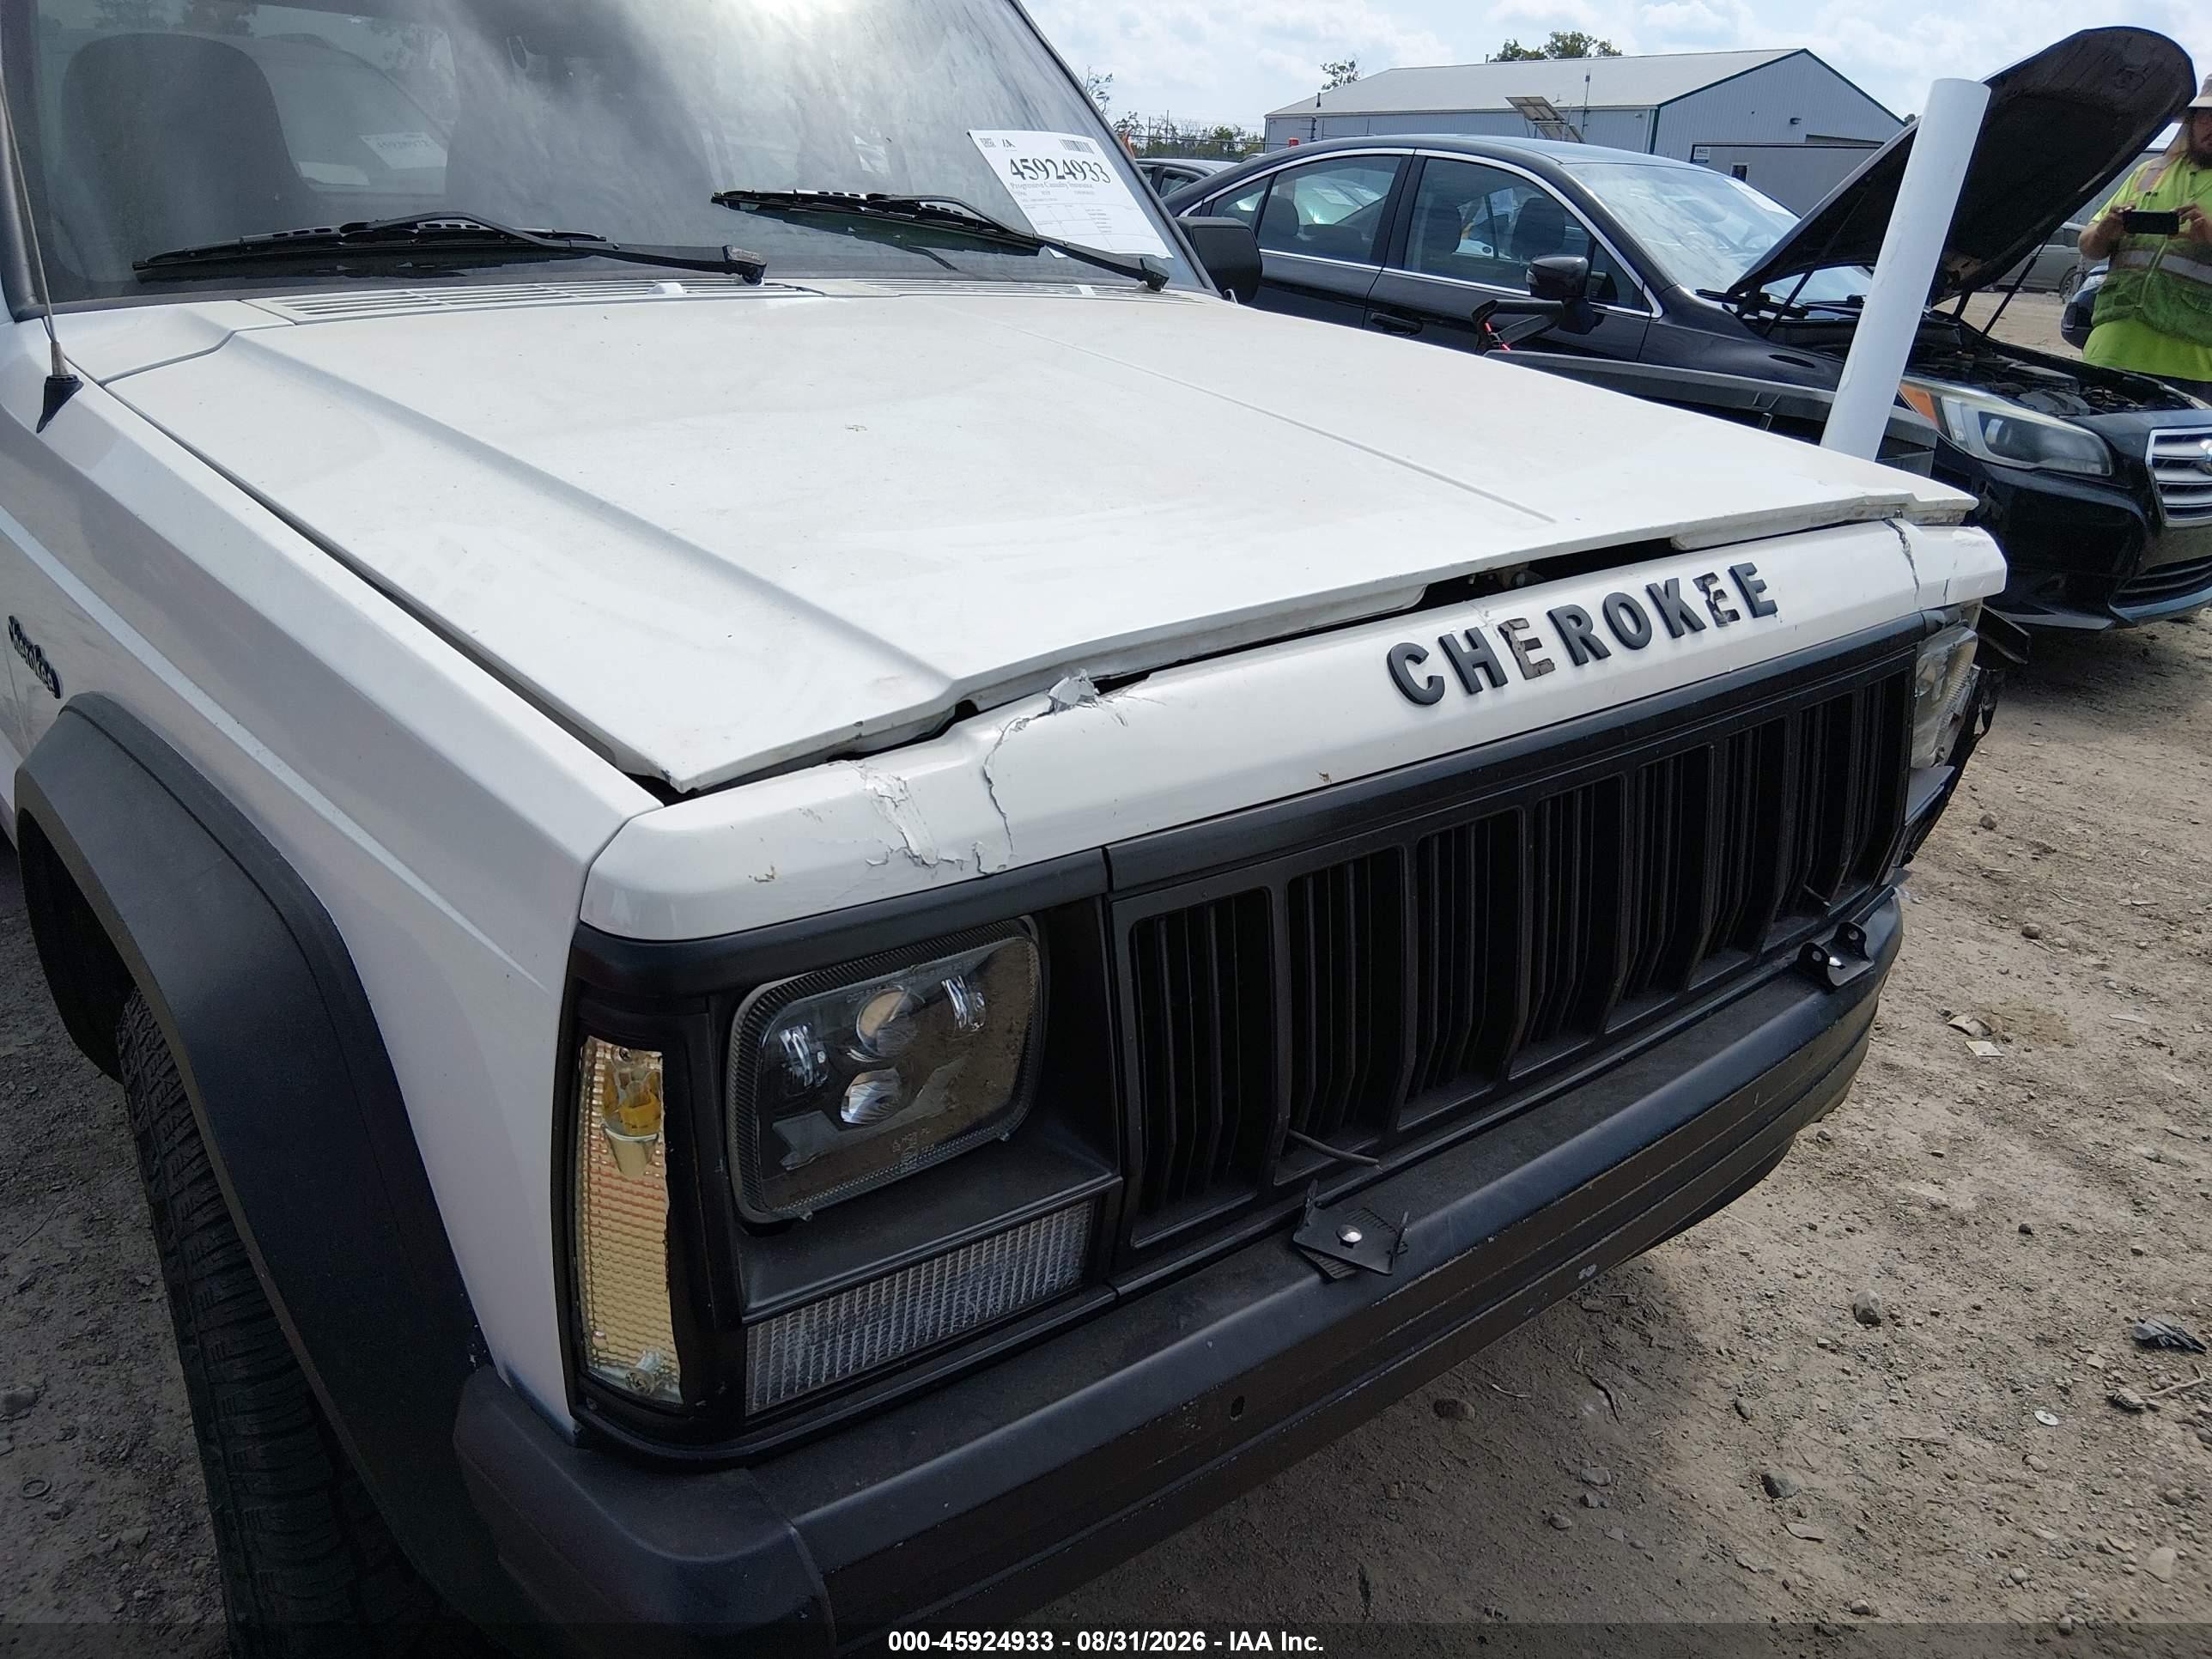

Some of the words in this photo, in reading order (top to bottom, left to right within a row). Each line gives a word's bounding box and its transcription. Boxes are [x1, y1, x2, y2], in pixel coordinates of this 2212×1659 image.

[1009, 158, 1111, 184] 45924933
[8, 615, 62, 700] Cherokee
[1386, 562, 1778, 706] CHEROKEE
